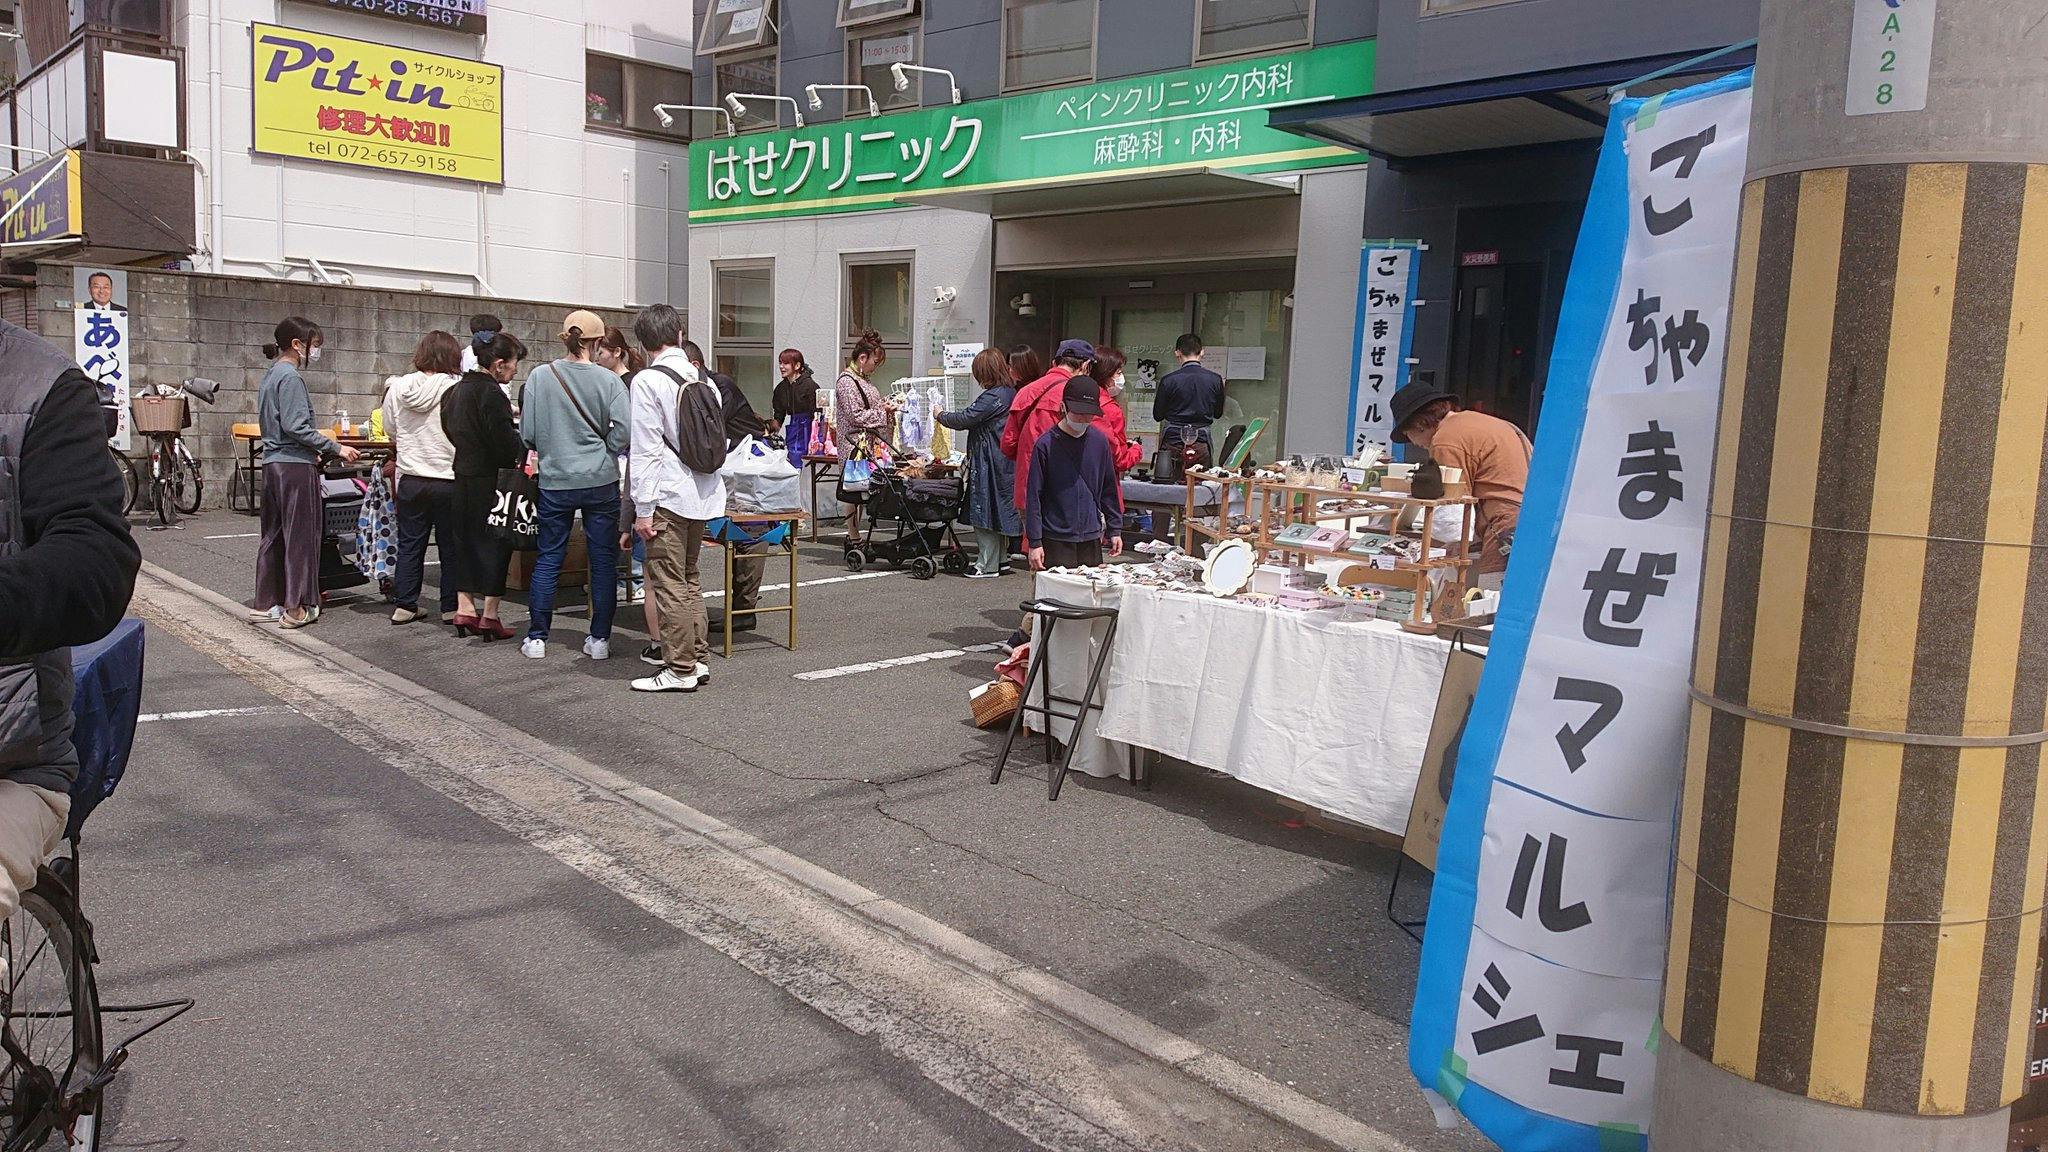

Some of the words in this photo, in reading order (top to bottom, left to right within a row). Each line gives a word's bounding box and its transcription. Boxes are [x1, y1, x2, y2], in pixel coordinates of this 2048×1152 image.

[413, 62, 496, 86] サイクルショップ
[1056, 61, 1294, 121] ペインクリニック内科
[308, 140, 331, 155] tel
[338, 144, 458, 173] 072-657-9158
[708, 116, 983, 200] はせクリニック
[1094, 118, 1242, 166] 麻酔科・内科
[1471, 124, 1717, 1094] ごちゃまぜマルシェ
